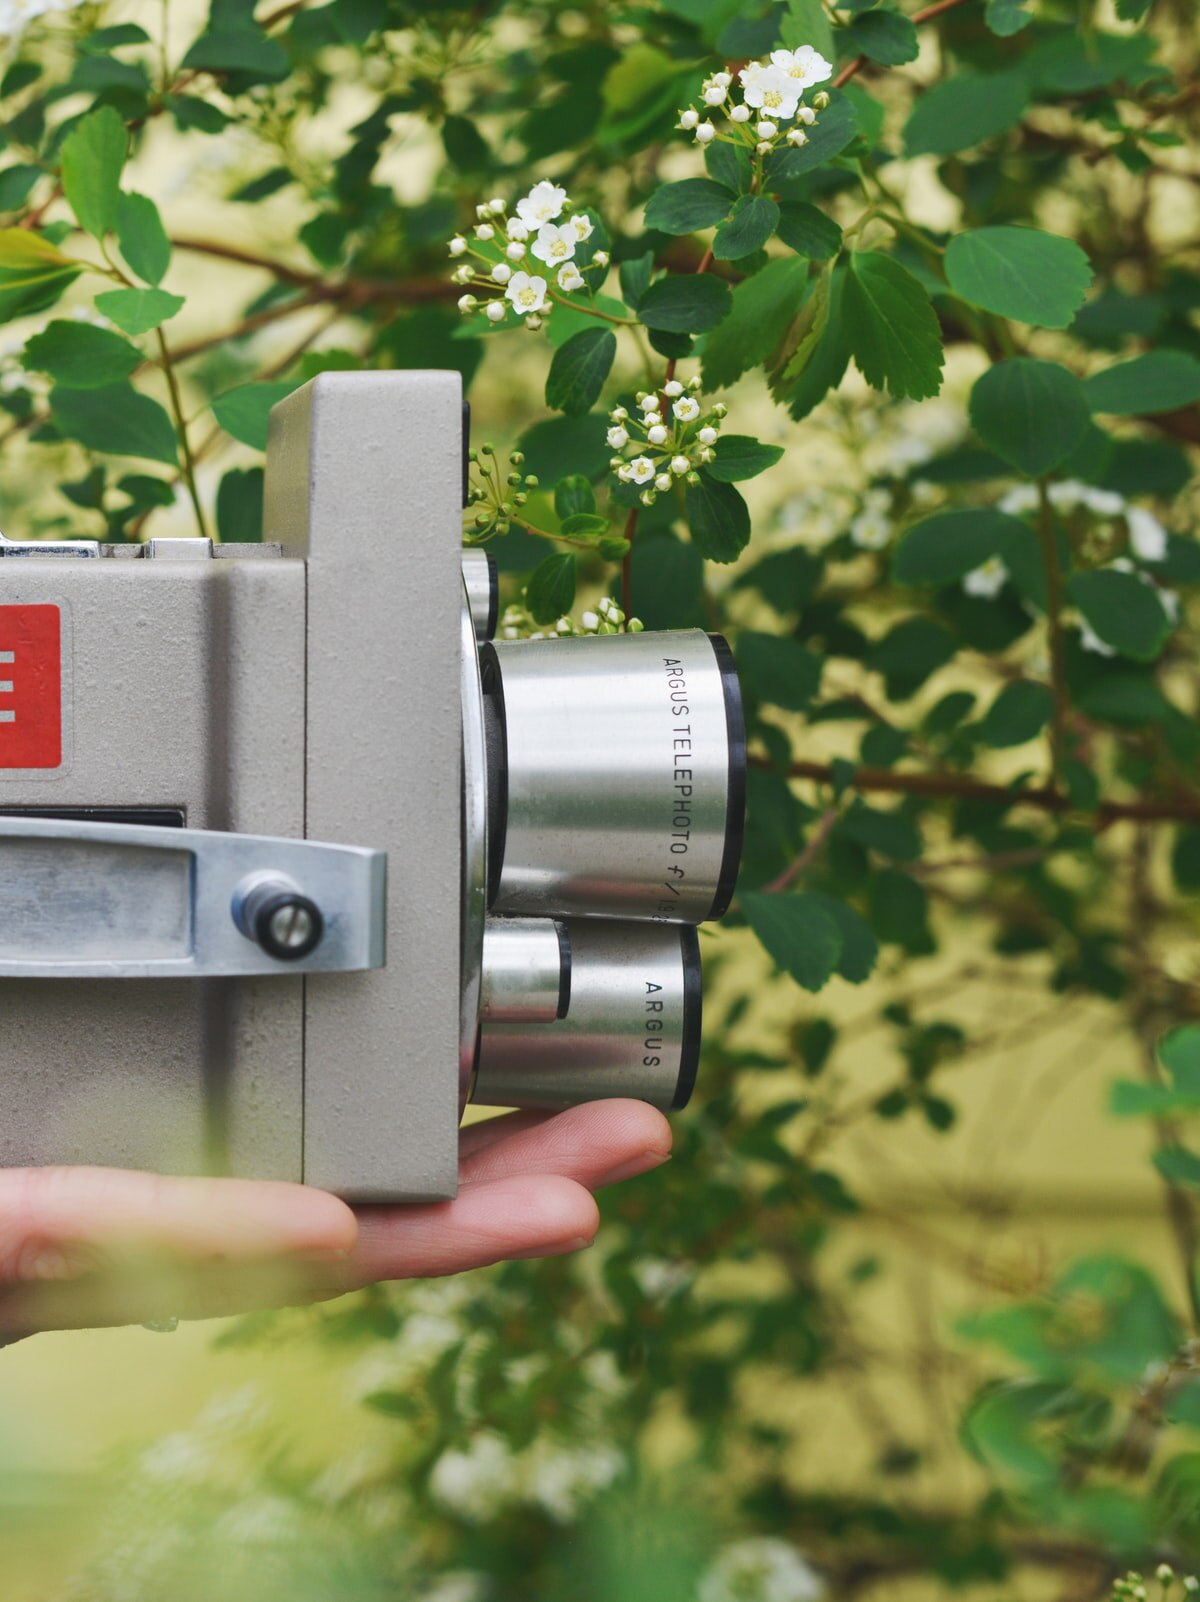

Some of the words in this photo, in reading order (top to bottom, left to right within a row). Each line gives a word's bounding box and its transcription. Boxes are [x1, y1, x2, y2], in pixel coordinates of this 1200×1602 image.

[662, 658, 690, 716] ARGUS
[669, 724, 693, 854] TELEPHOTO
[642, 981, 664, 1067] ARGUS
